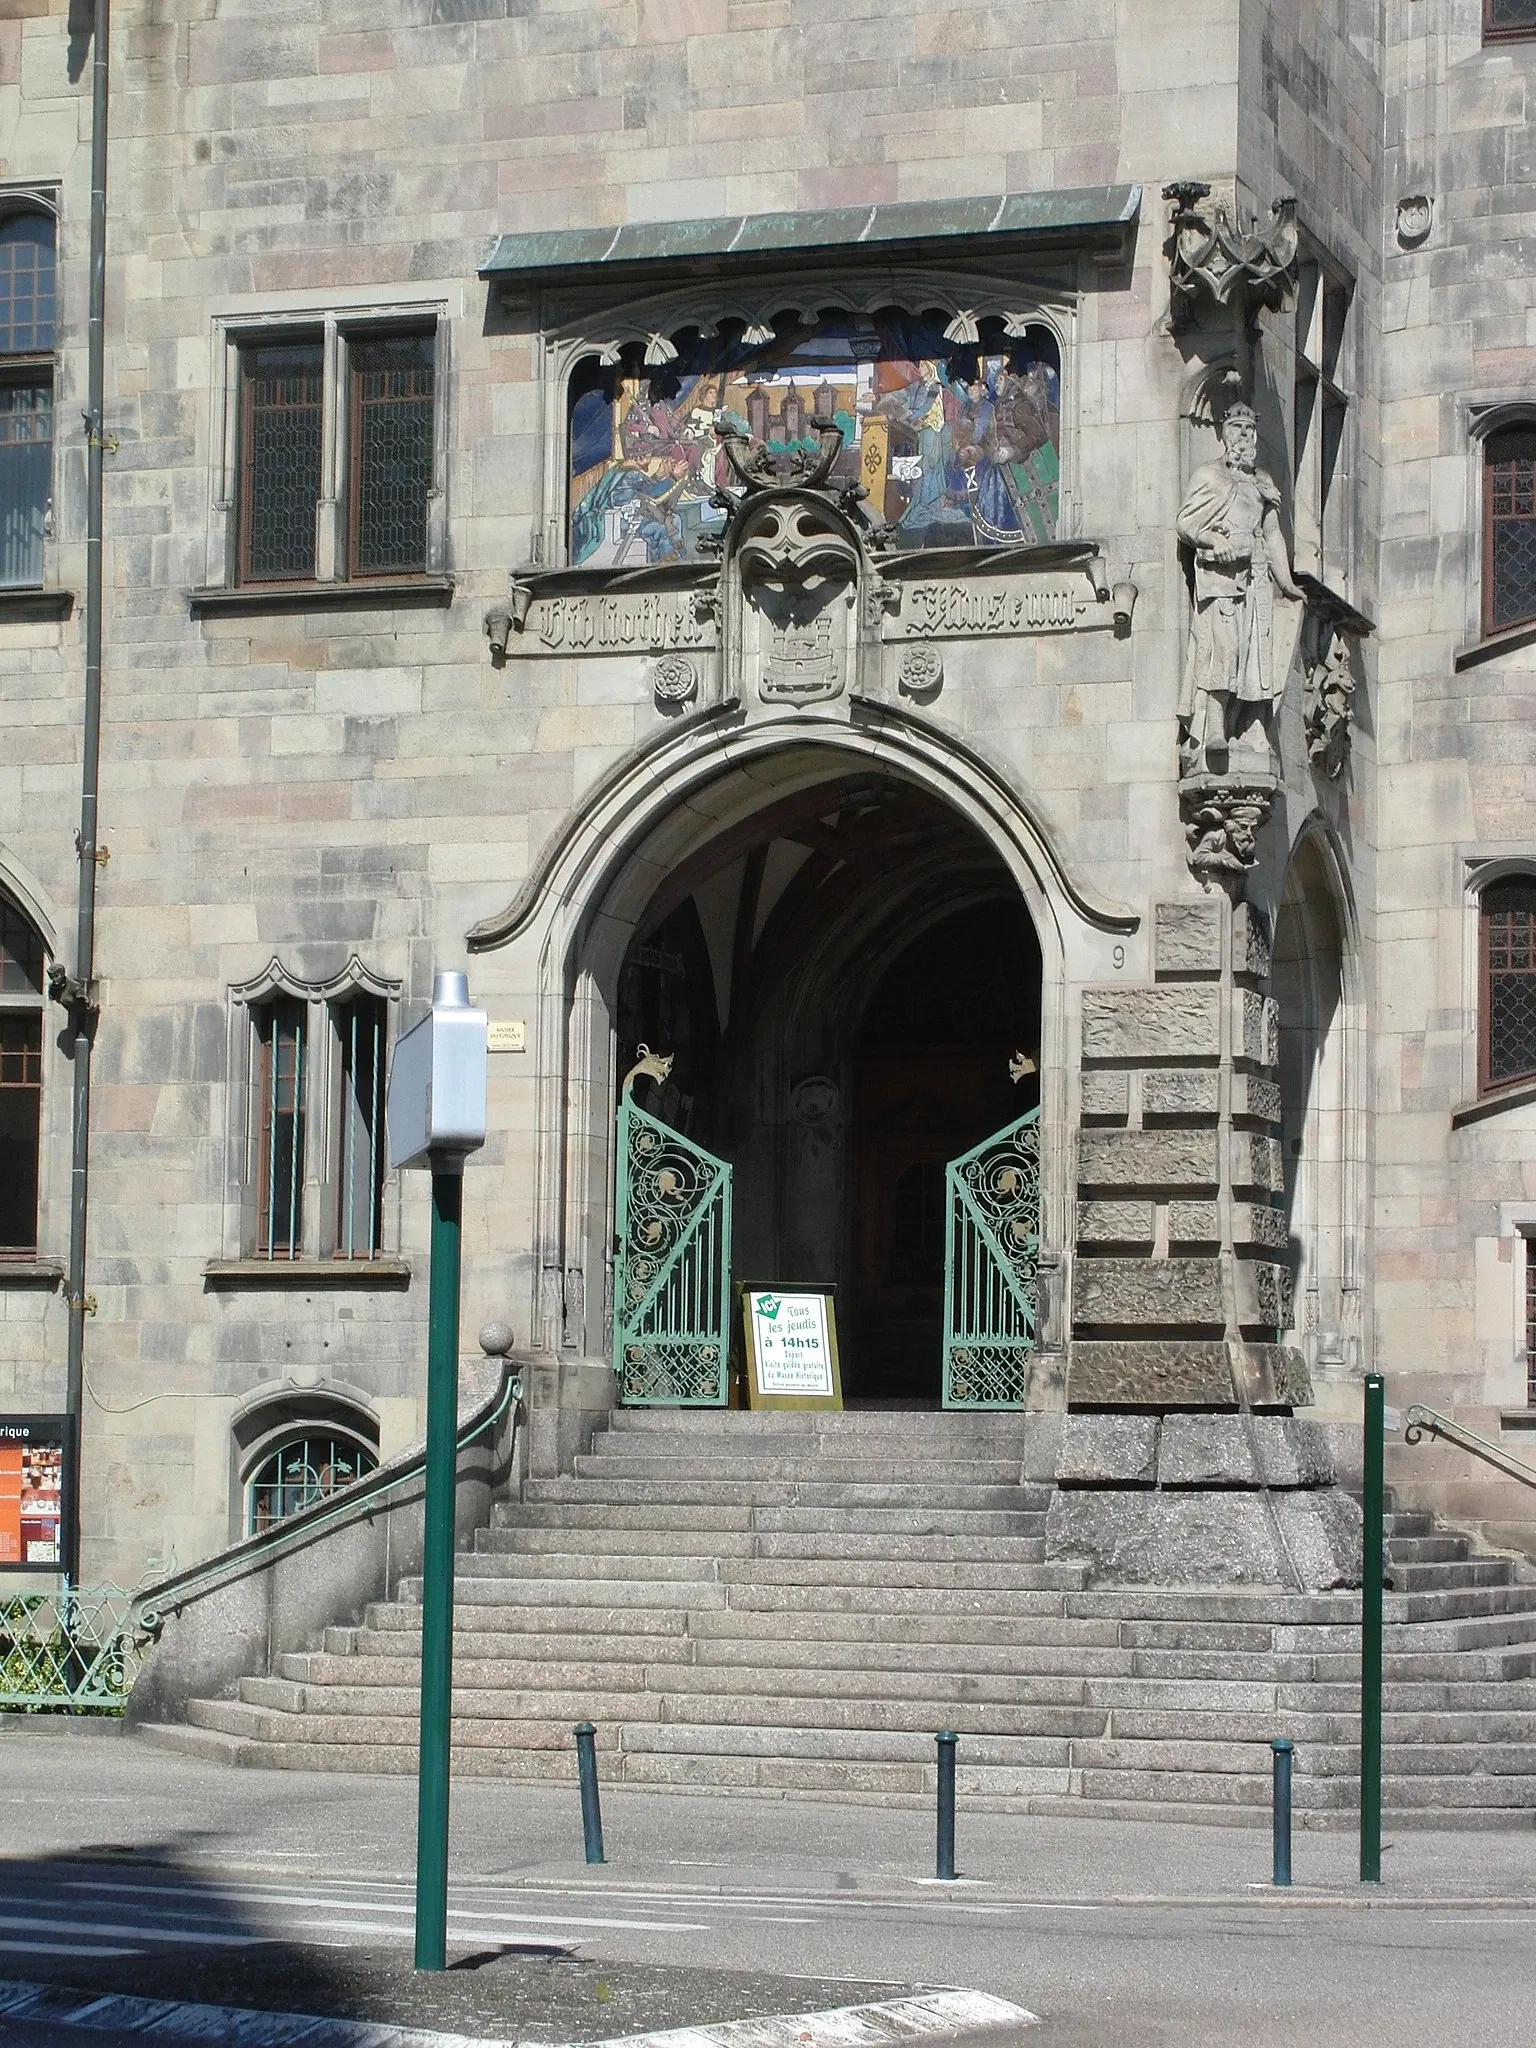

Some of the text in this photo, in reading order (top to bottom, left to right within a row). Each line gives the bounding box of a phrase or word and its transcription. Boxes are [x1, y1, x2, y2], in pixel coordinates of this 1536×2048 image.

[1112, 944, 1125, 970] 9
[760, 1298, 777, 1314] ICI
[787, 1306, 810, 1317] Tous
[768, 1318, 817, 1334] les jeudis
[764, 1336, 819, 1349] à 14h15
